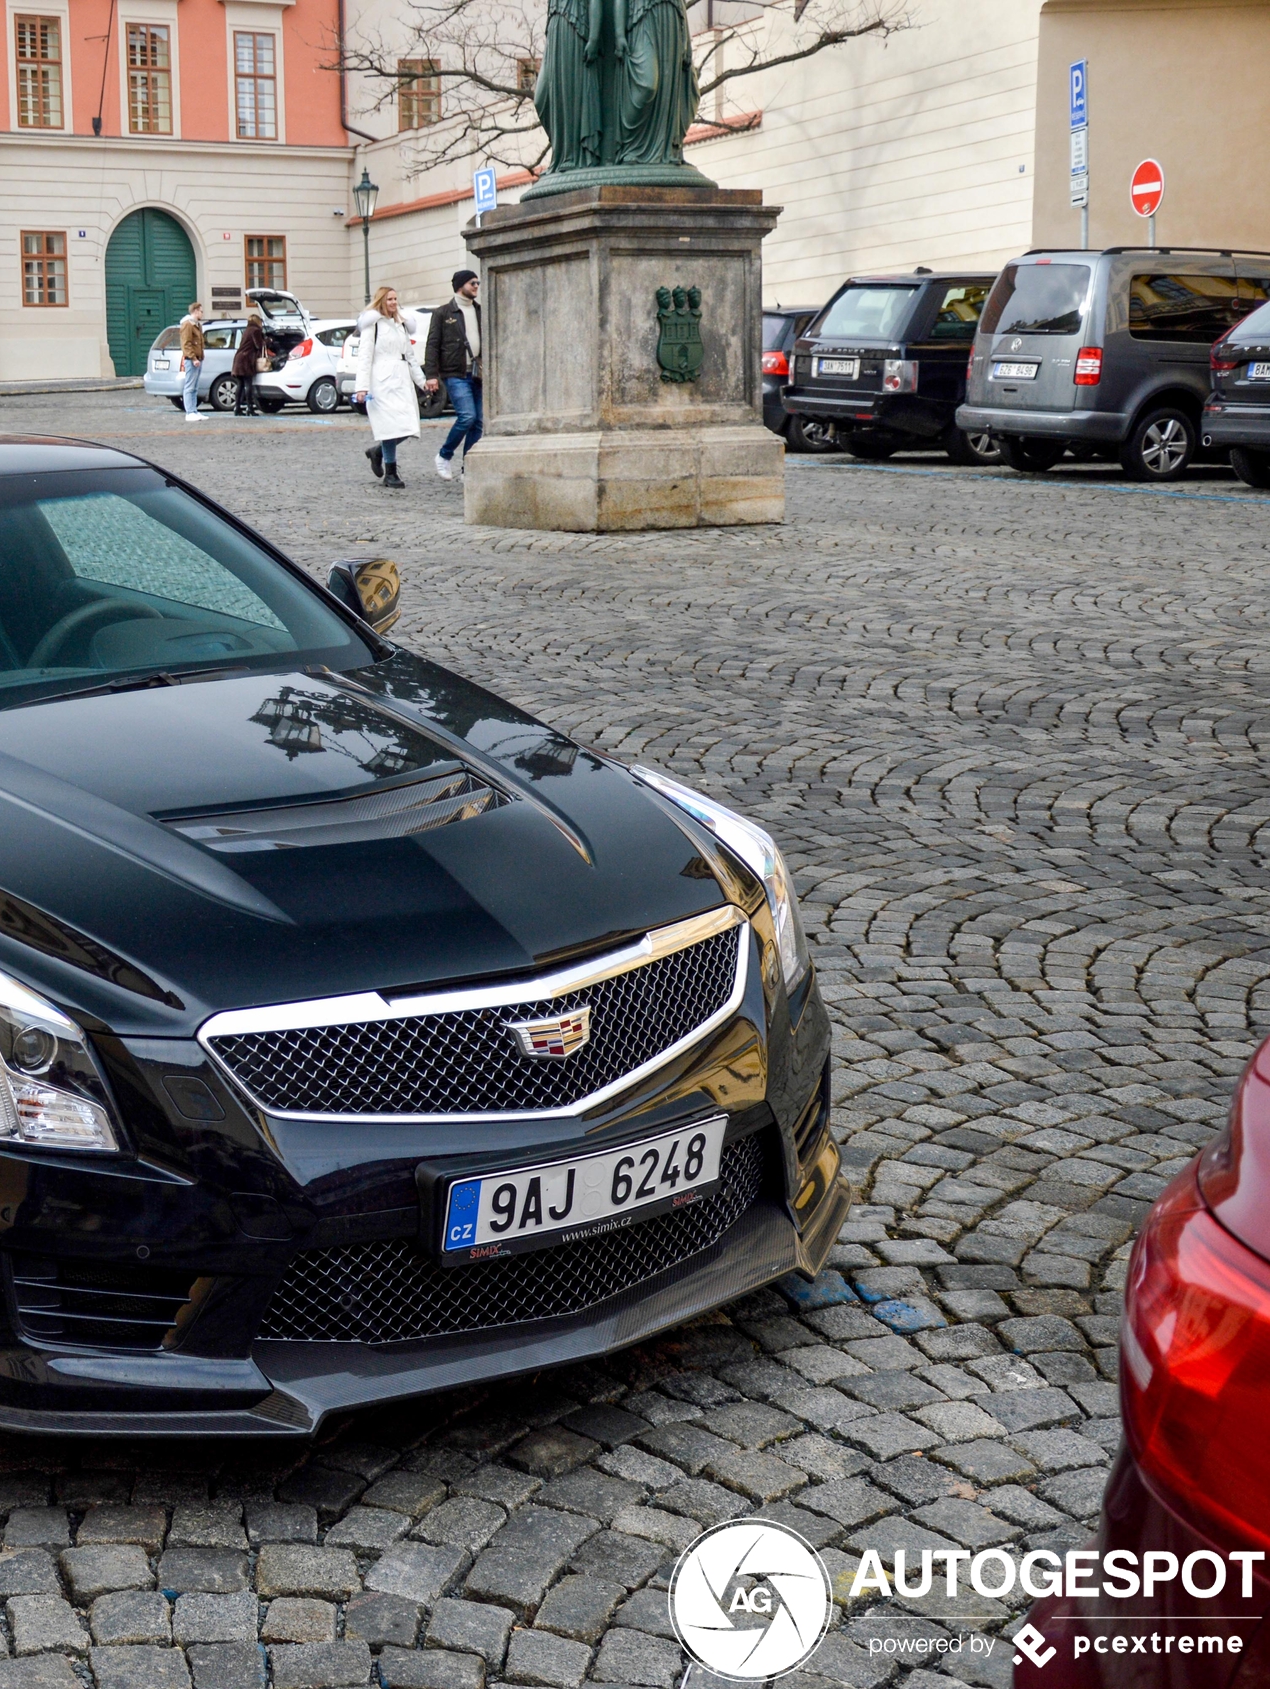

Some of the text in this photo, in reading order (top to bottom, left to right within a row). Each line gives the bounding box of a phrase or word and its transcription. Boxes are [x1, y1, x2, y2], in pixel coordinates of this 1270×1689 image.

[1072, 69, 1083, 108] P
[478, 174, 491, 200] P
[489, 1132, 707, 1233] 9AJ 6248
[450, 1223, 472, 1241] CZ
[561, 1216, 632, 1243] www.simix.cz
